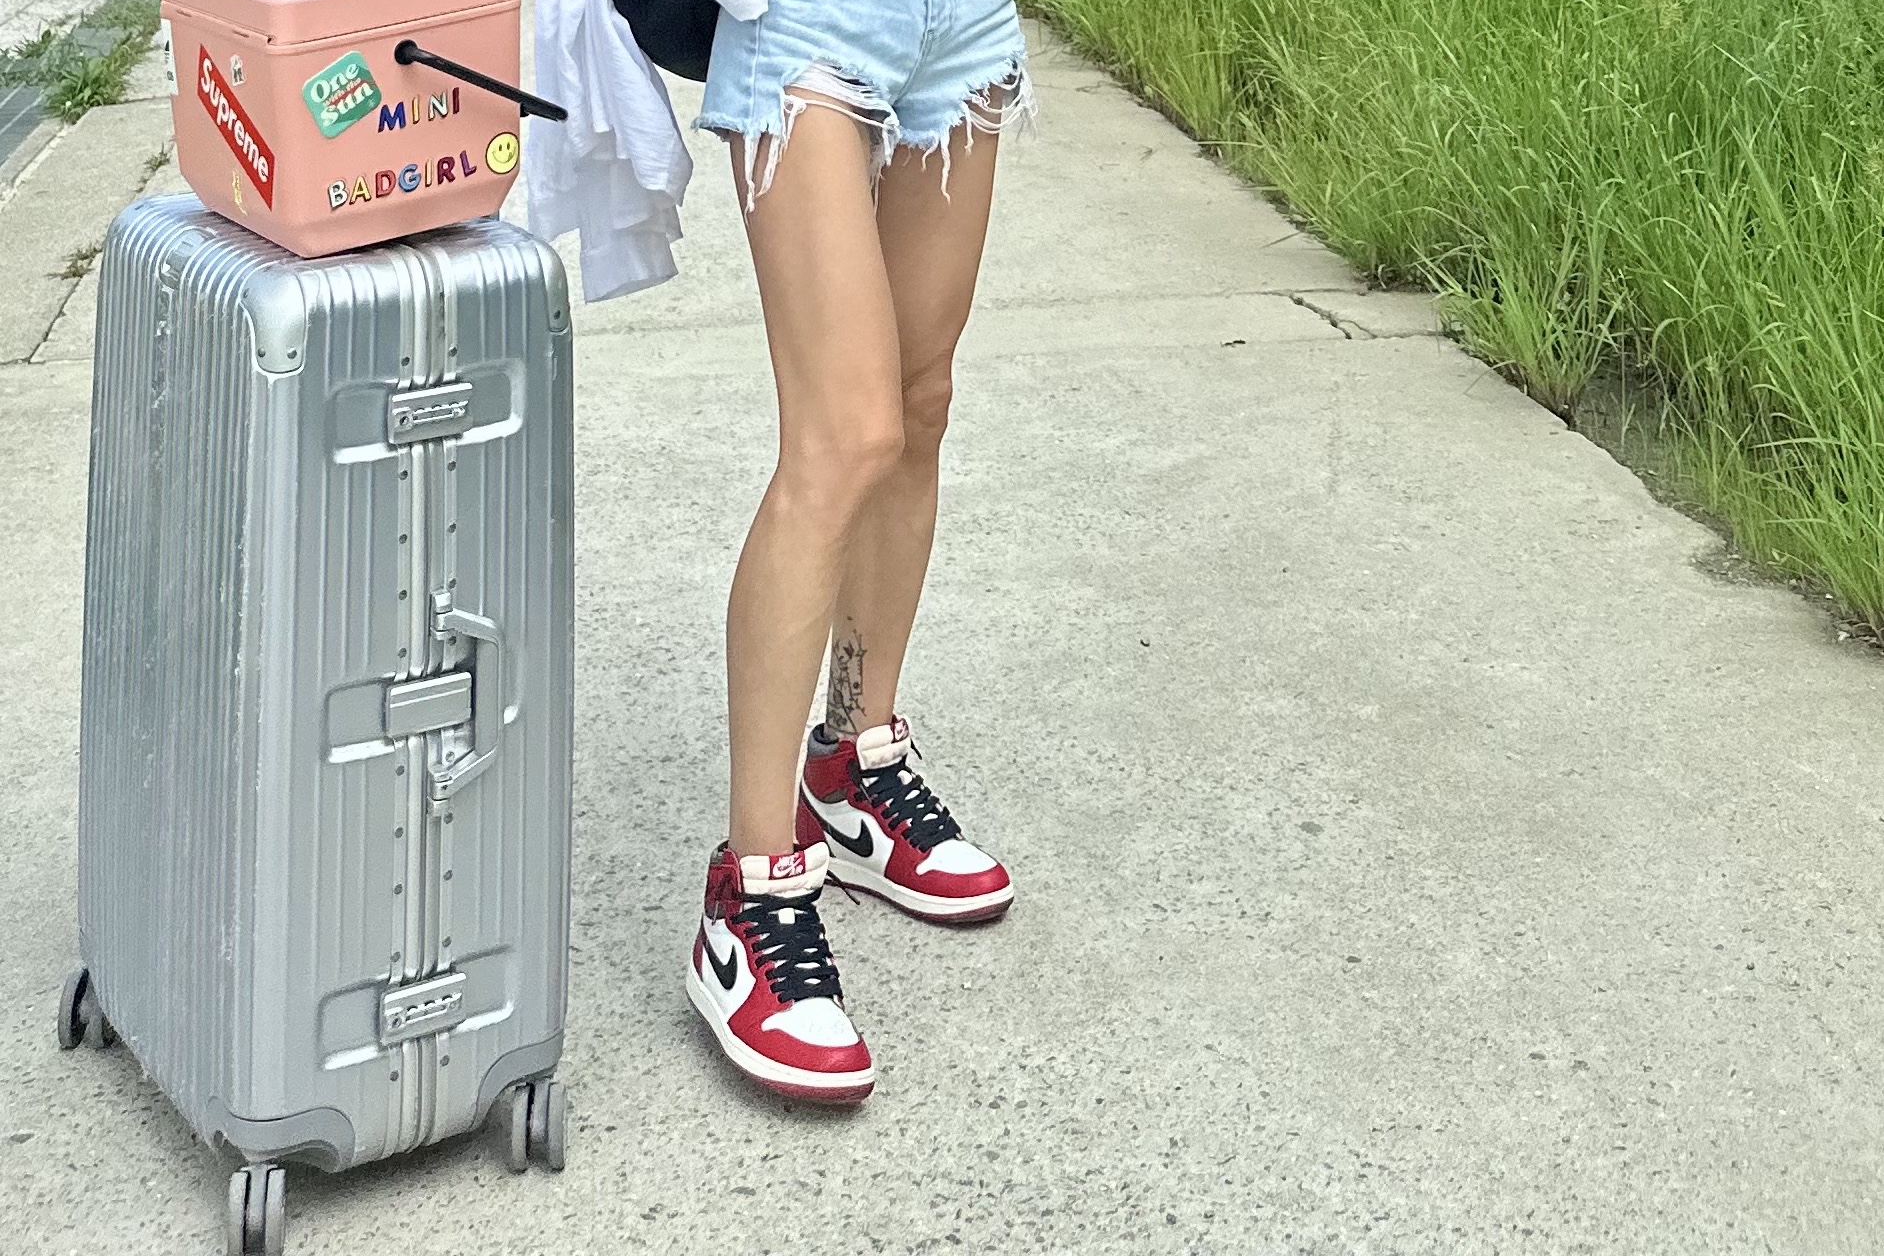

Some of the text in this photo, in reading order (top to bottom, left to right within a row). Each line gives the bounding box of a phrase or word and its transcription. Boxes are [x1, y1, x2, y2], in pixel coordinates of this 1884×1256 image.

[310, 63, 360, 103] One
[320, 82, 374, 127] Sun
[201, 57, 269, 183] Supreme
[378, 87, 460, 133] MINI
[327, 149, 478, 211] BADGIRL
